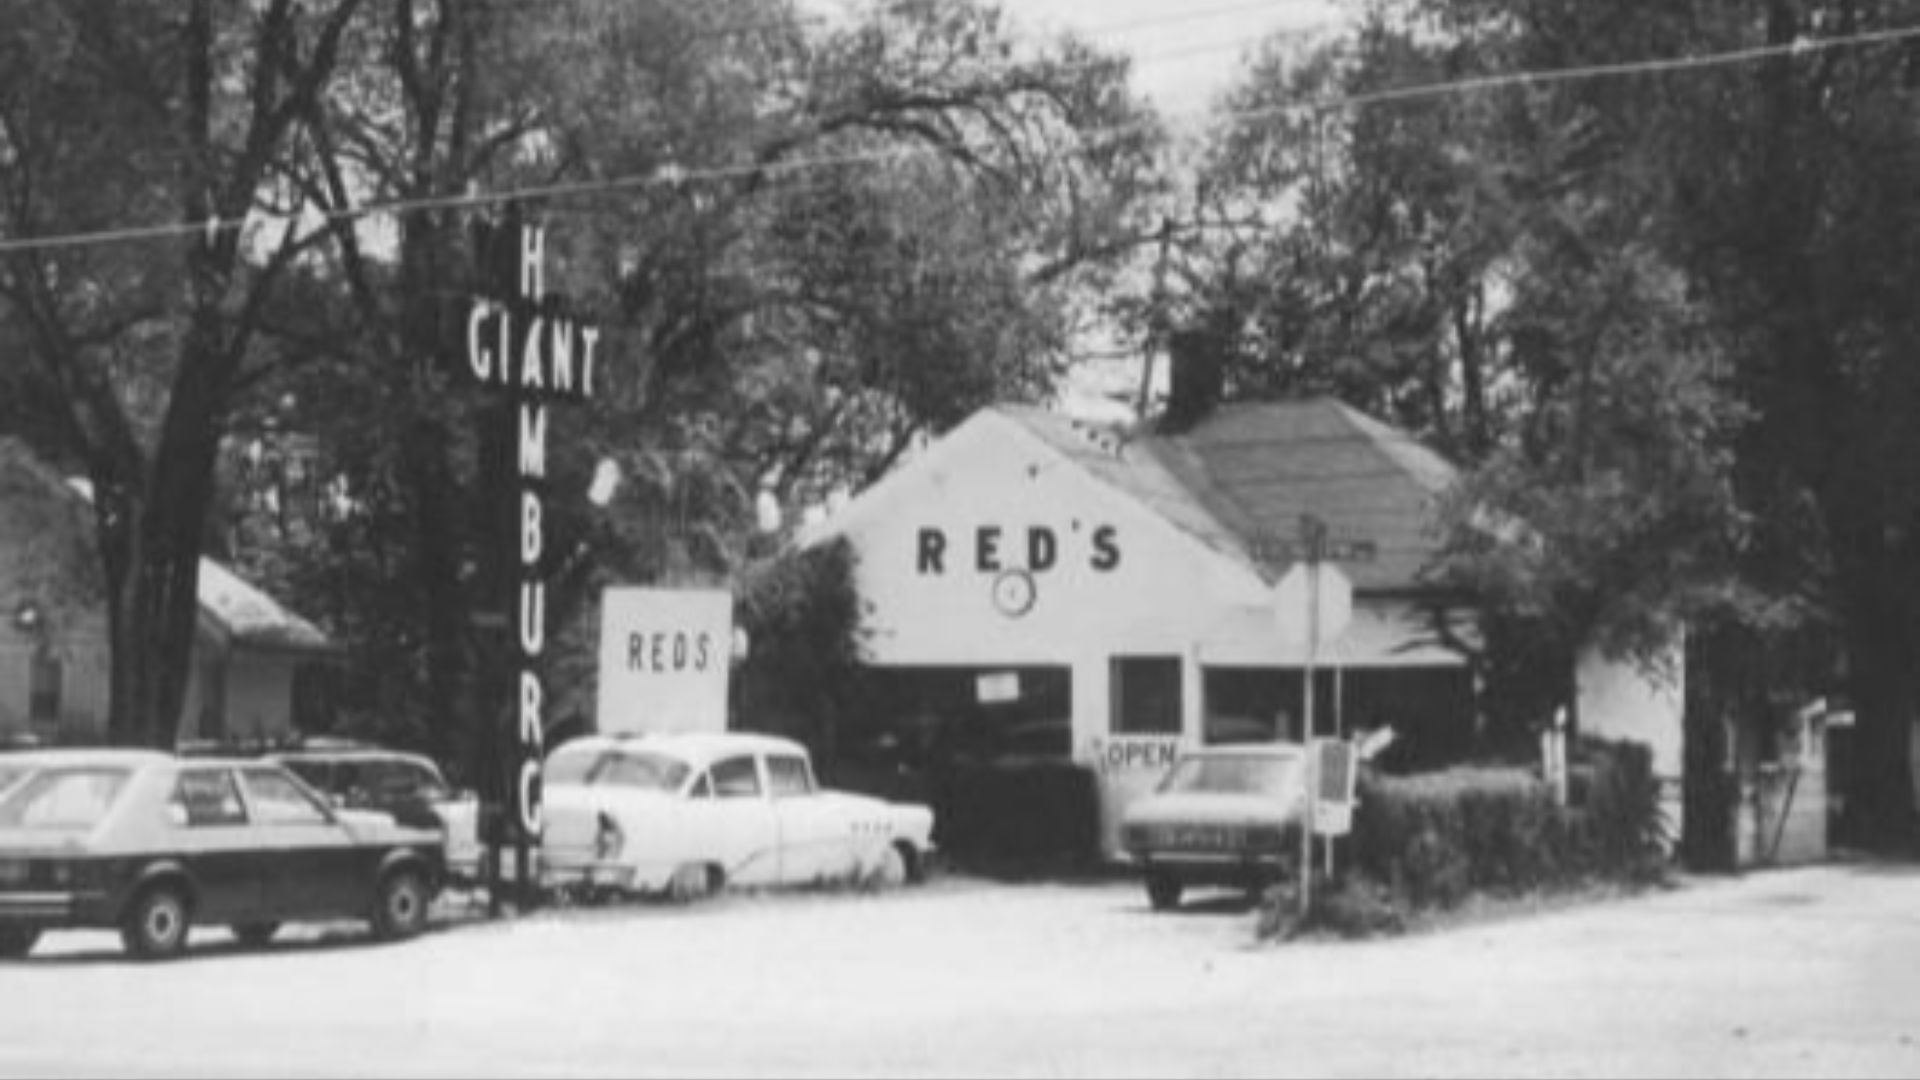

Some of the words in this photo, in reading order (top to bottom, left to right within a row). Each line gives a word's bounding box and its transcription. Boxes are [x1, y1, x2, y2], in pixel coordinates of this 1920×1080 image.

[468, 300, 599, 396] GIANT
[916, 517, 1121, 575] RED'S
[1107, 741, 1175, 767] OPEN
